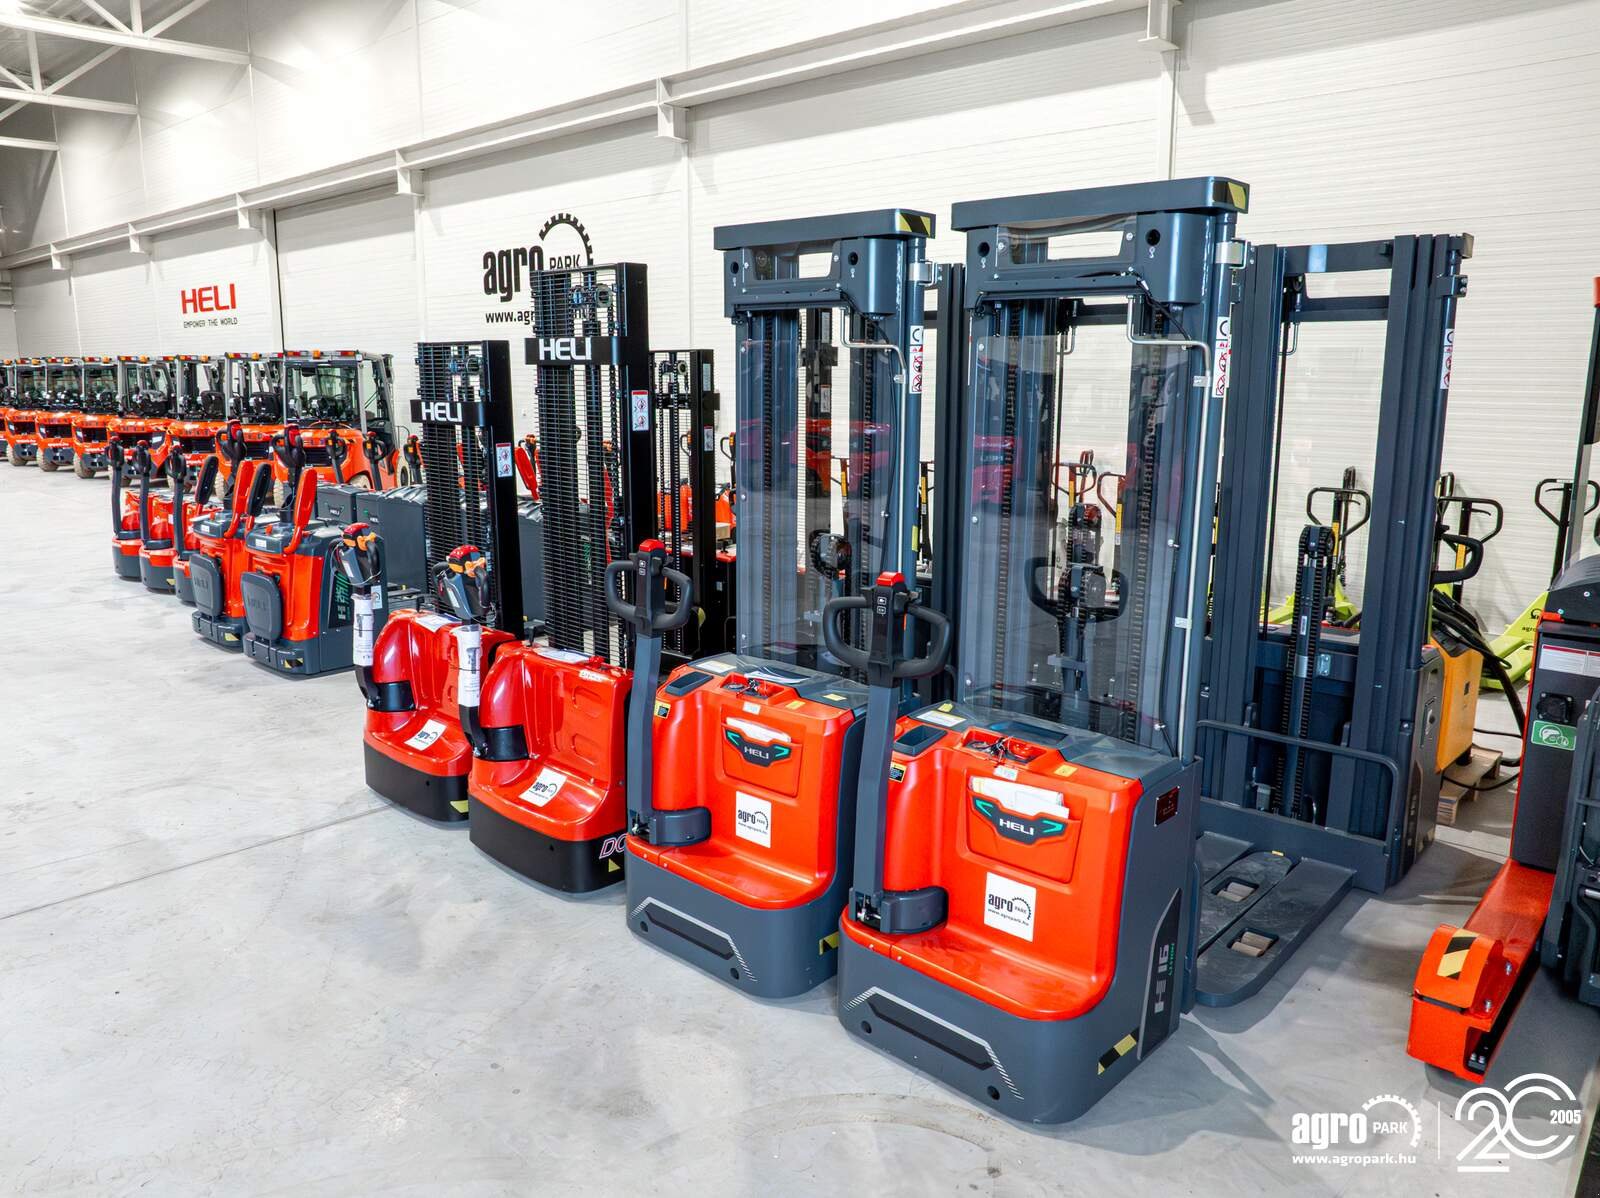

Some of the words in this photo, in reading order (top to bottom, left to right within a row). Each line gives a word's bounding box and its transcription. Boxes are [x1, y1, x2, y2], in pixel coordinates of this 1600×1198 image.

[483, 246, 544, 303] agro
[549, 254, 581, 270] PARK
[181, 283, 236, 314] HELI
[183, 320, 205, 328] EMPOWER
[208, 318, 218, 327] THE
[220, 316, 238, 325] WORLD
[539, 337, 593, 361] HELI
[421, 401, 463, 422] HELI
[743, 745, 769, 760] HELI
[737, 809, 756, 825] agro
[999, 818, 1035, 836] HELI
[988, 893, 1013, 913] agro
[1014, 906, 1027, 915] PARK
[988, 908, 1029, 926] www.agropark.hu
